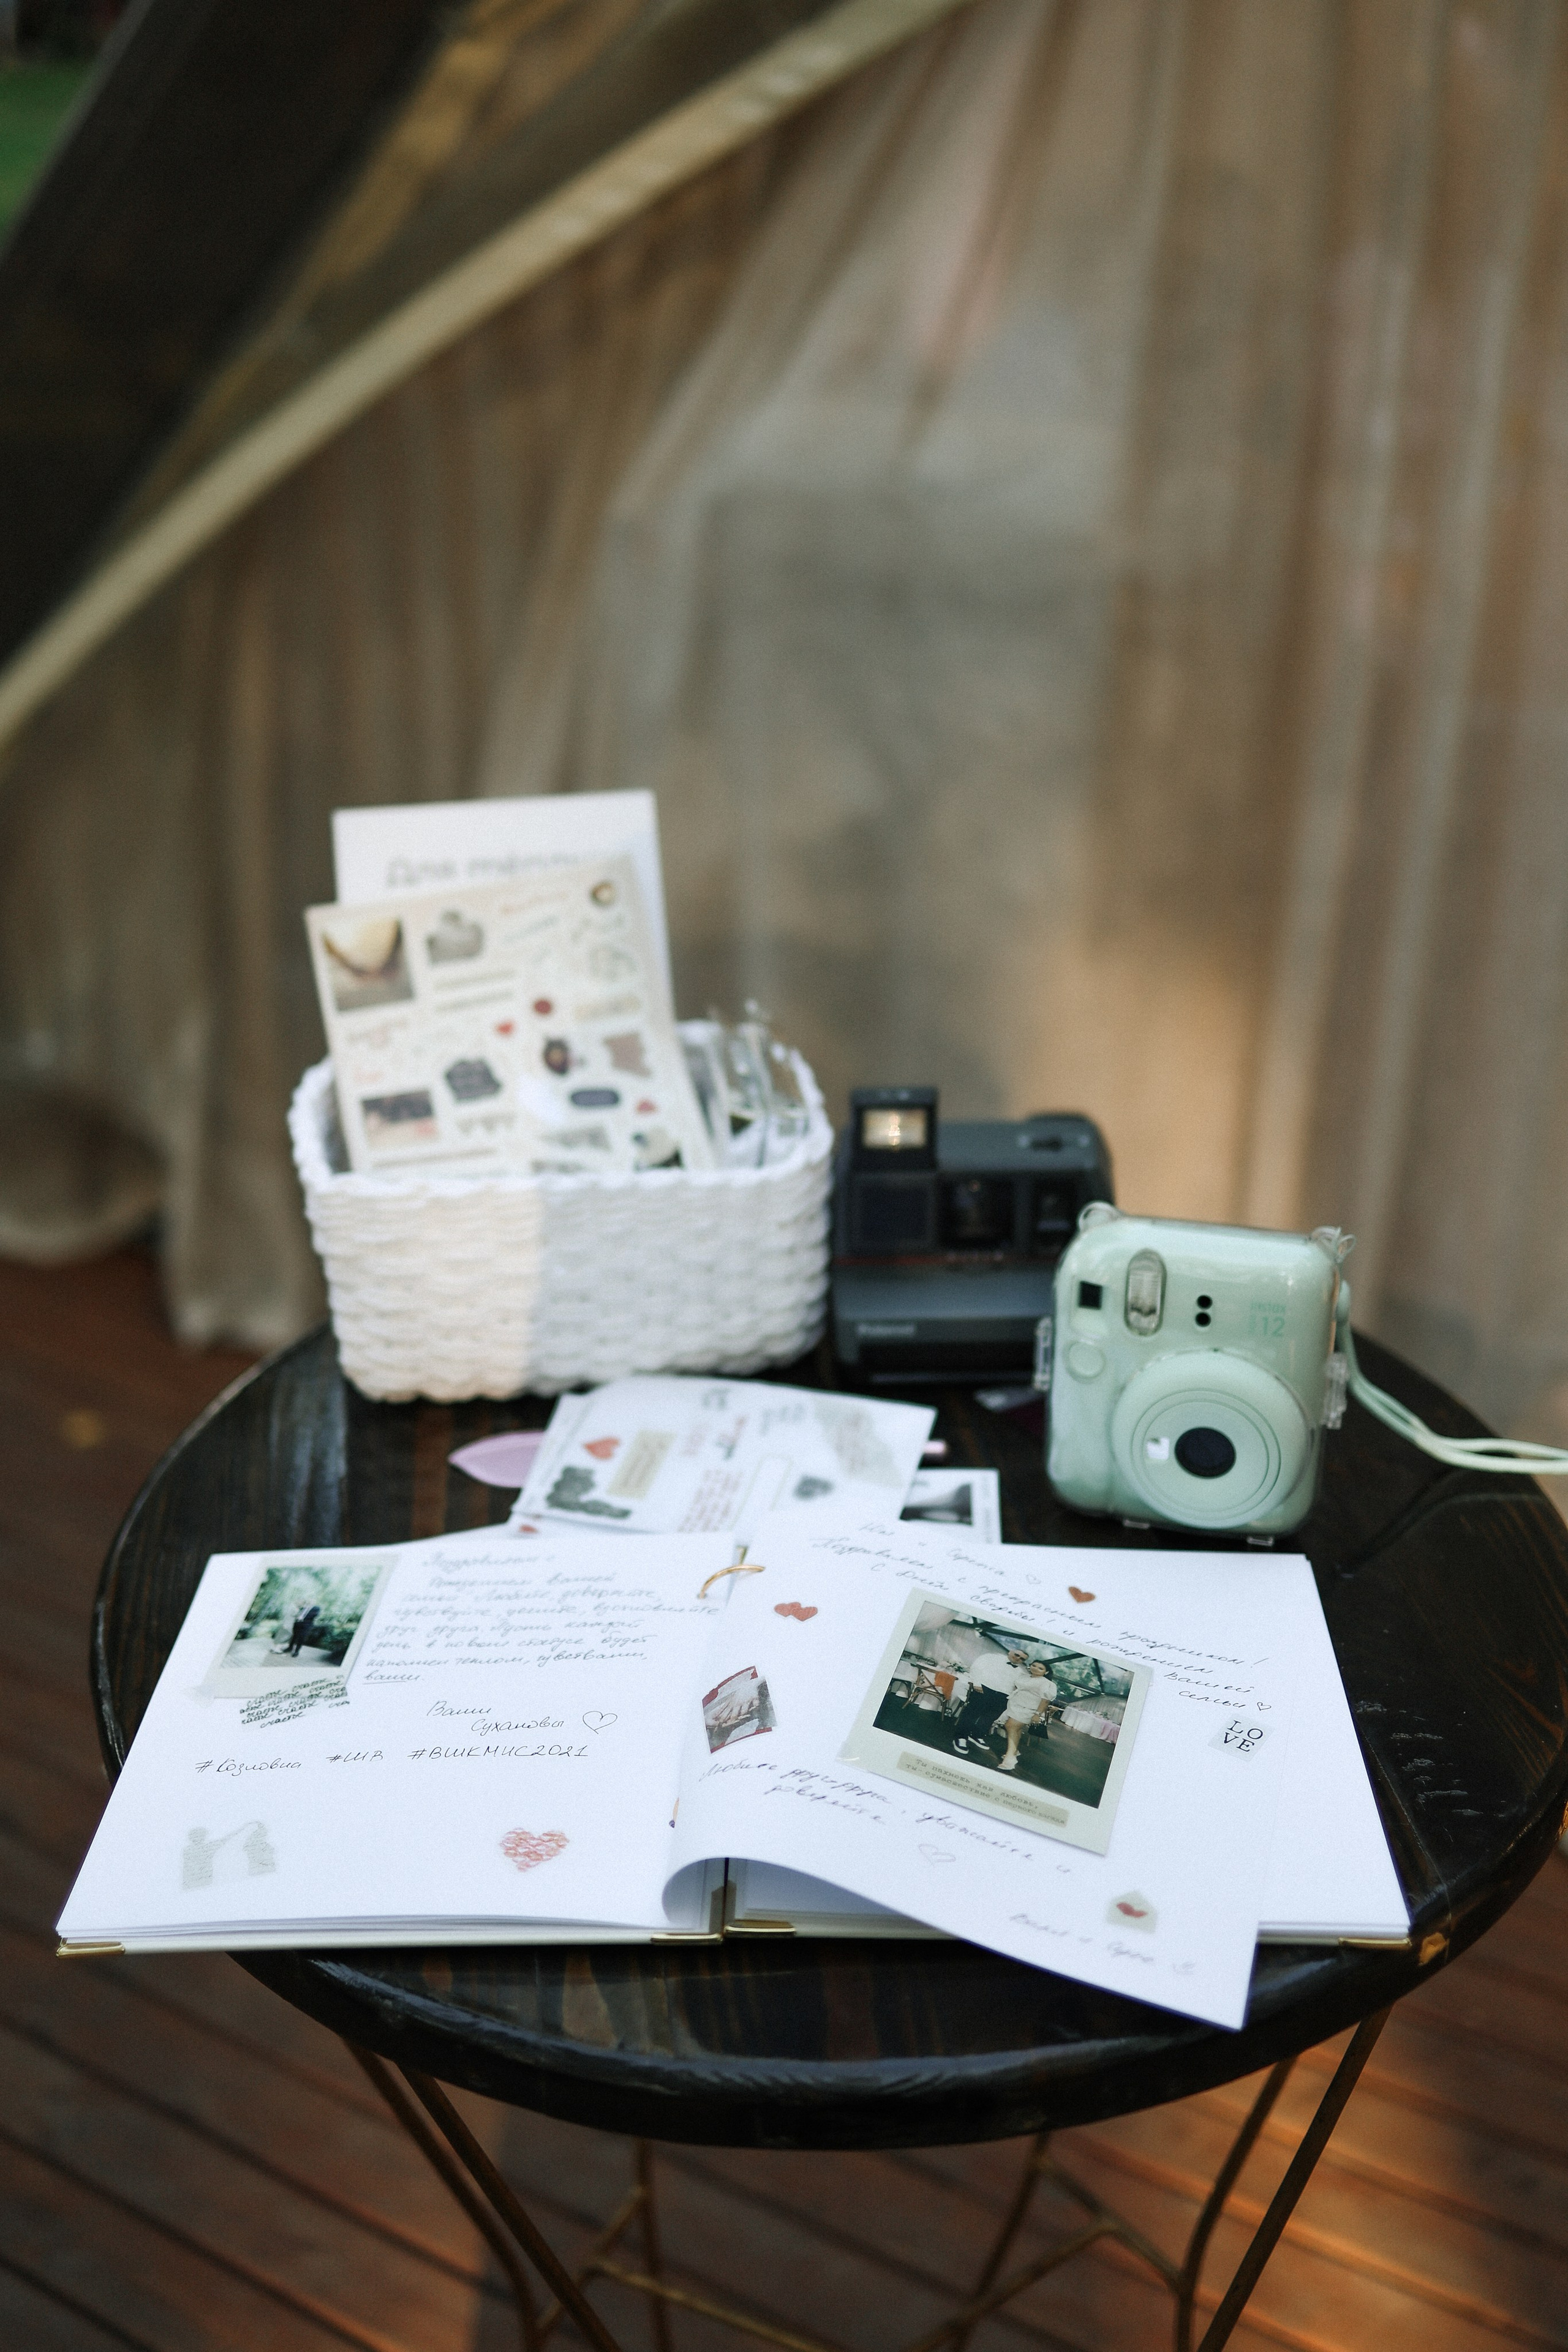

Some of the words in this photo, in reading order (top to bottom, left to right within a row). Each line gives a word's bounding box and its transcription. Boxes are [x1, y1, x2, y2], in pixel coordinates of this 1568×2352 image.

[1262, 1316, 1285, 1336] 12
[427, 1700, 492, 1716] Ваши
[471, 1716, 564, 1736] Сухановы
[916, 1758, 927, 1768] Ты
